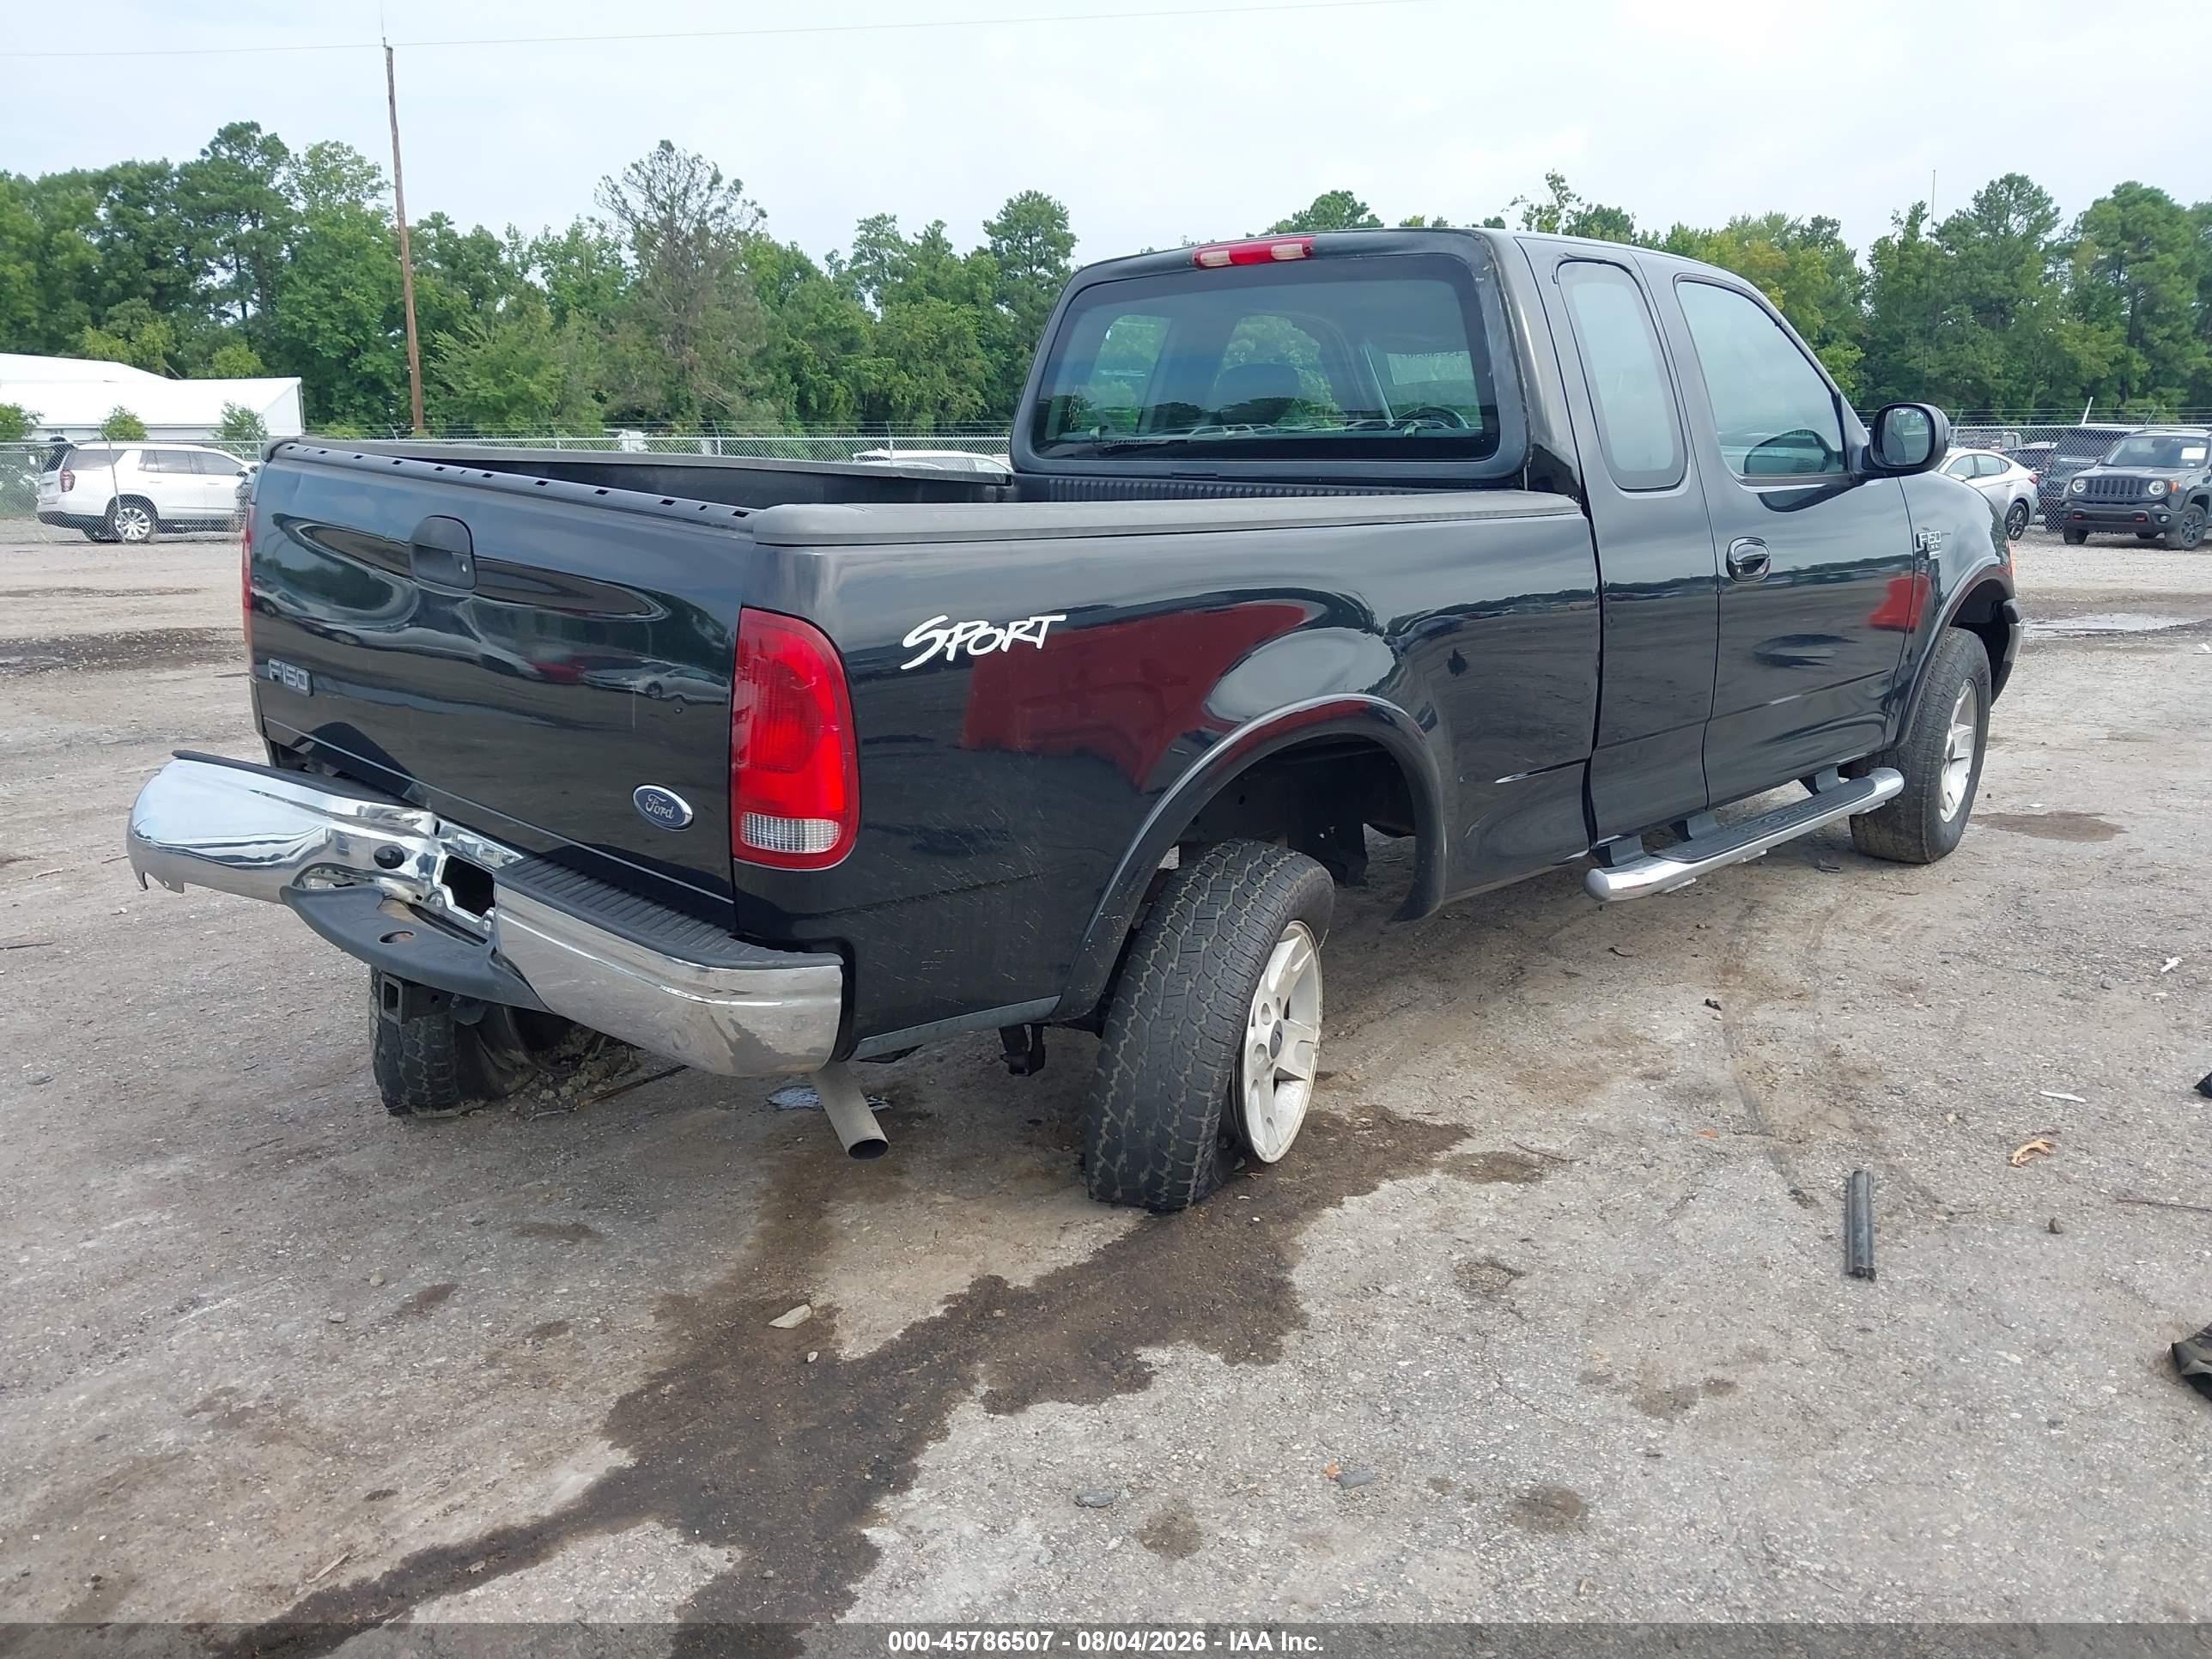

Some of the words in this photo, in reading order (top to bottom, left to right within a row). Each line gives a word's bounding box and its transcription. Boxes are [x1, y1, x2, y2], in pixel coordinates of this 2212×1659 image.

[1919, 531, 1941, 547] F150
[900, 614, 1066, 670] SPORT
[268, 659, 308, 690] F150
[646, 793, 674, 819] Ford
